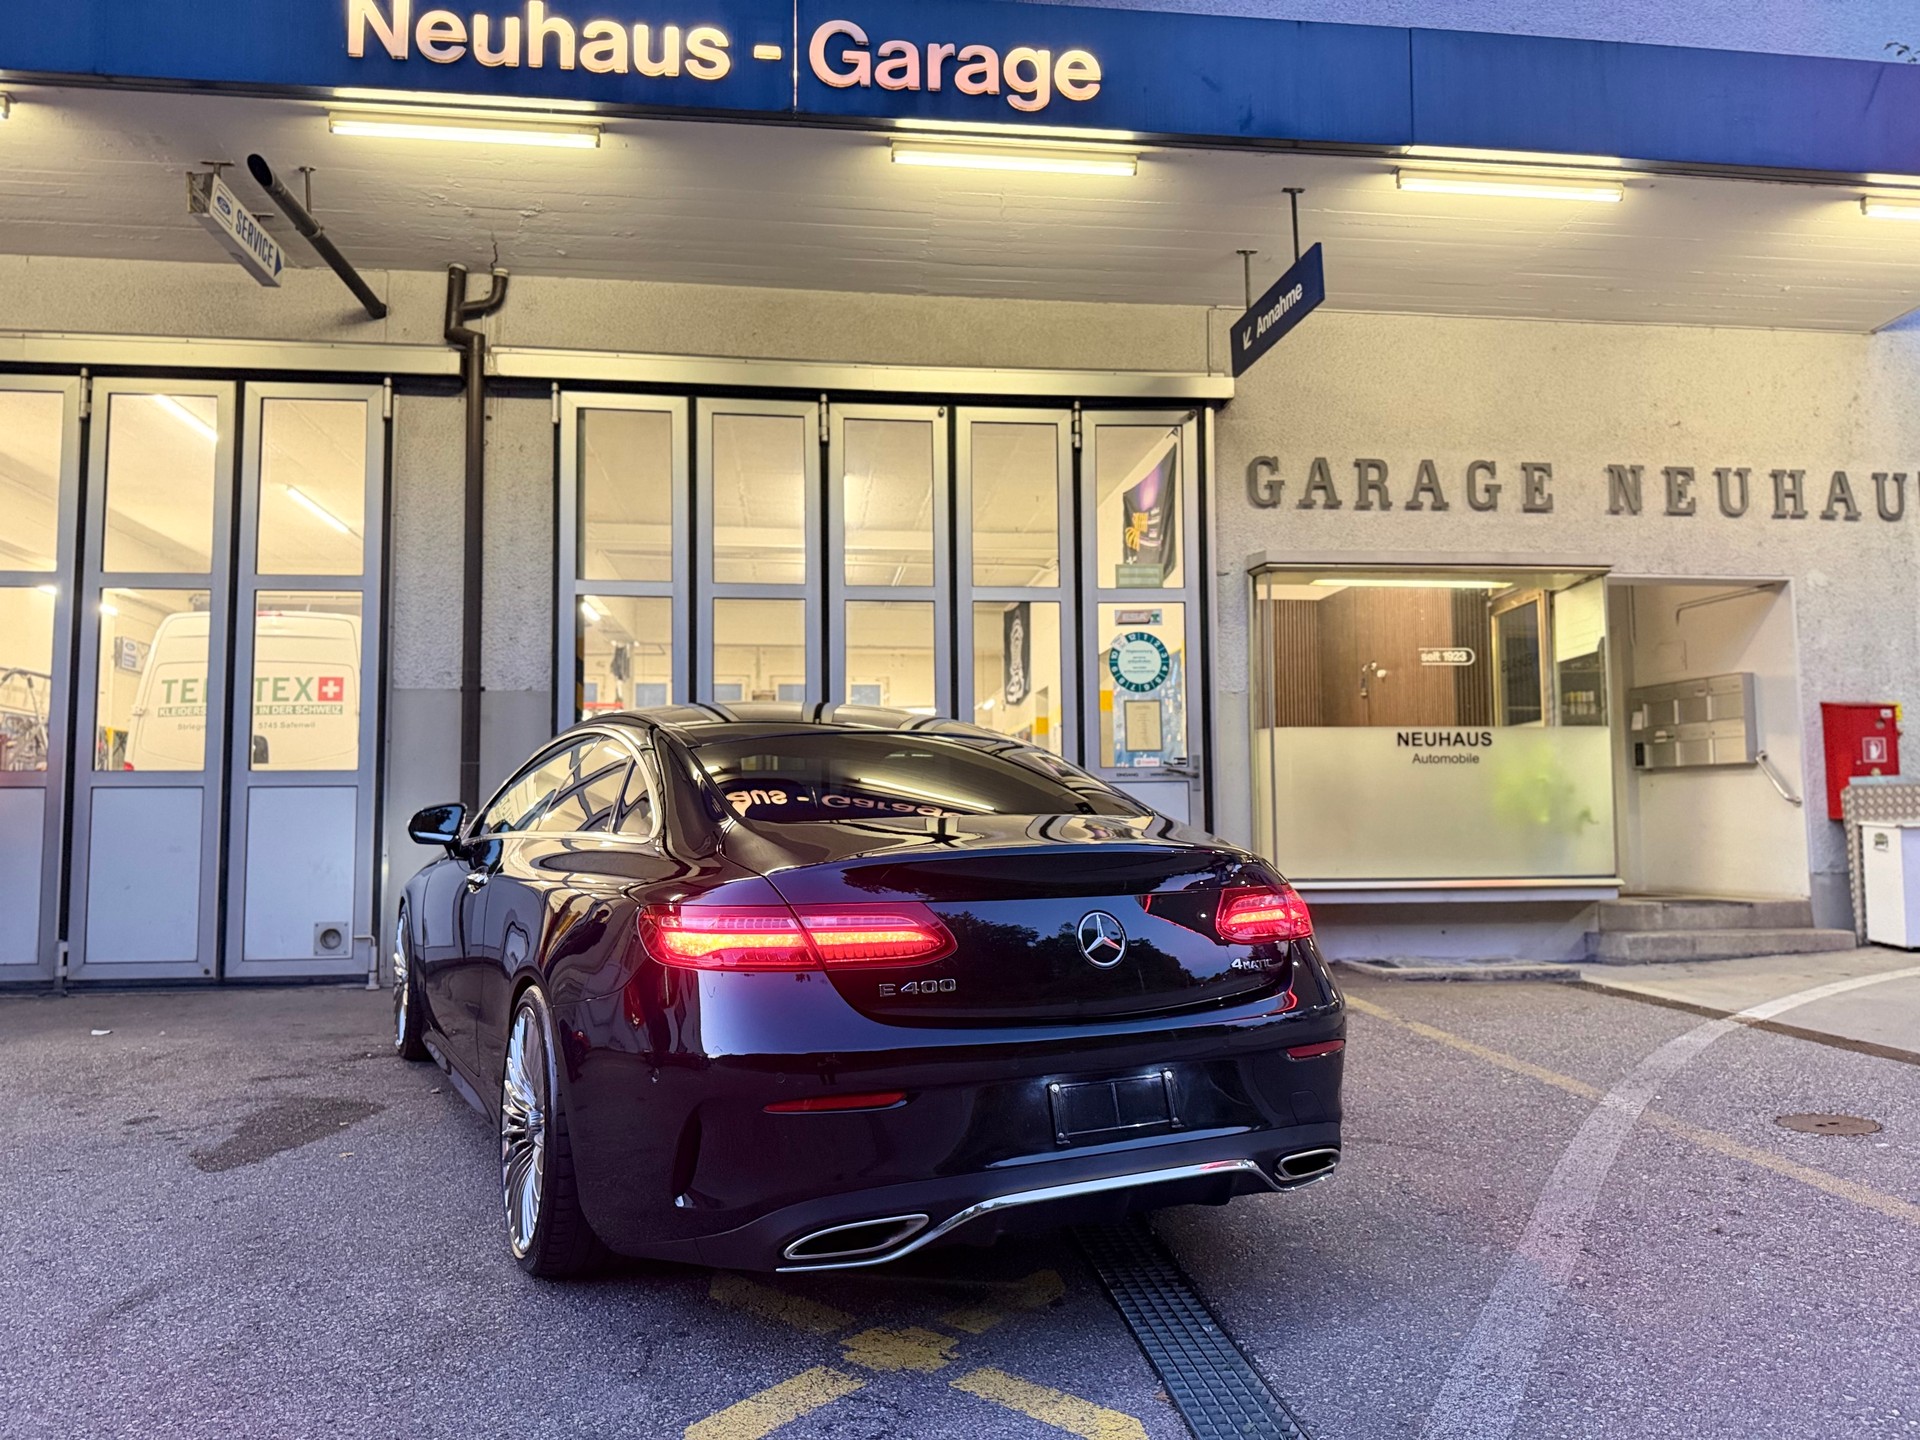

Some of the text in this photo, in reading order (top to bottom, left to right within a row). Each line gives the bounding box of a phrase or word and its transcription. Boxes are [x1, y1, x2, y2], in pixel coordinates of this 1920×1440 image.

[347, 0, 1102, 112] Neuhaus - Garage
[235, 209, 274, 268] SERVICE
[1256, 283, 1304, 339] Annahme
[1246, 455, 1920, 522] GARAGE NEUHAU
[1421, 651, 1467, 661] seit 1923
[162, 679, 208, 704] TE
[160, 705, 341, 716] KLEIDERS IN DER SCHWEIZ
[1397, 731, 1493, 747] NEUHAUS
[1412, 753, 1480, 765] Automobile
[1231, 958, 1274, 970] 4MATIC
[878, 978, 957, 997] E 400
